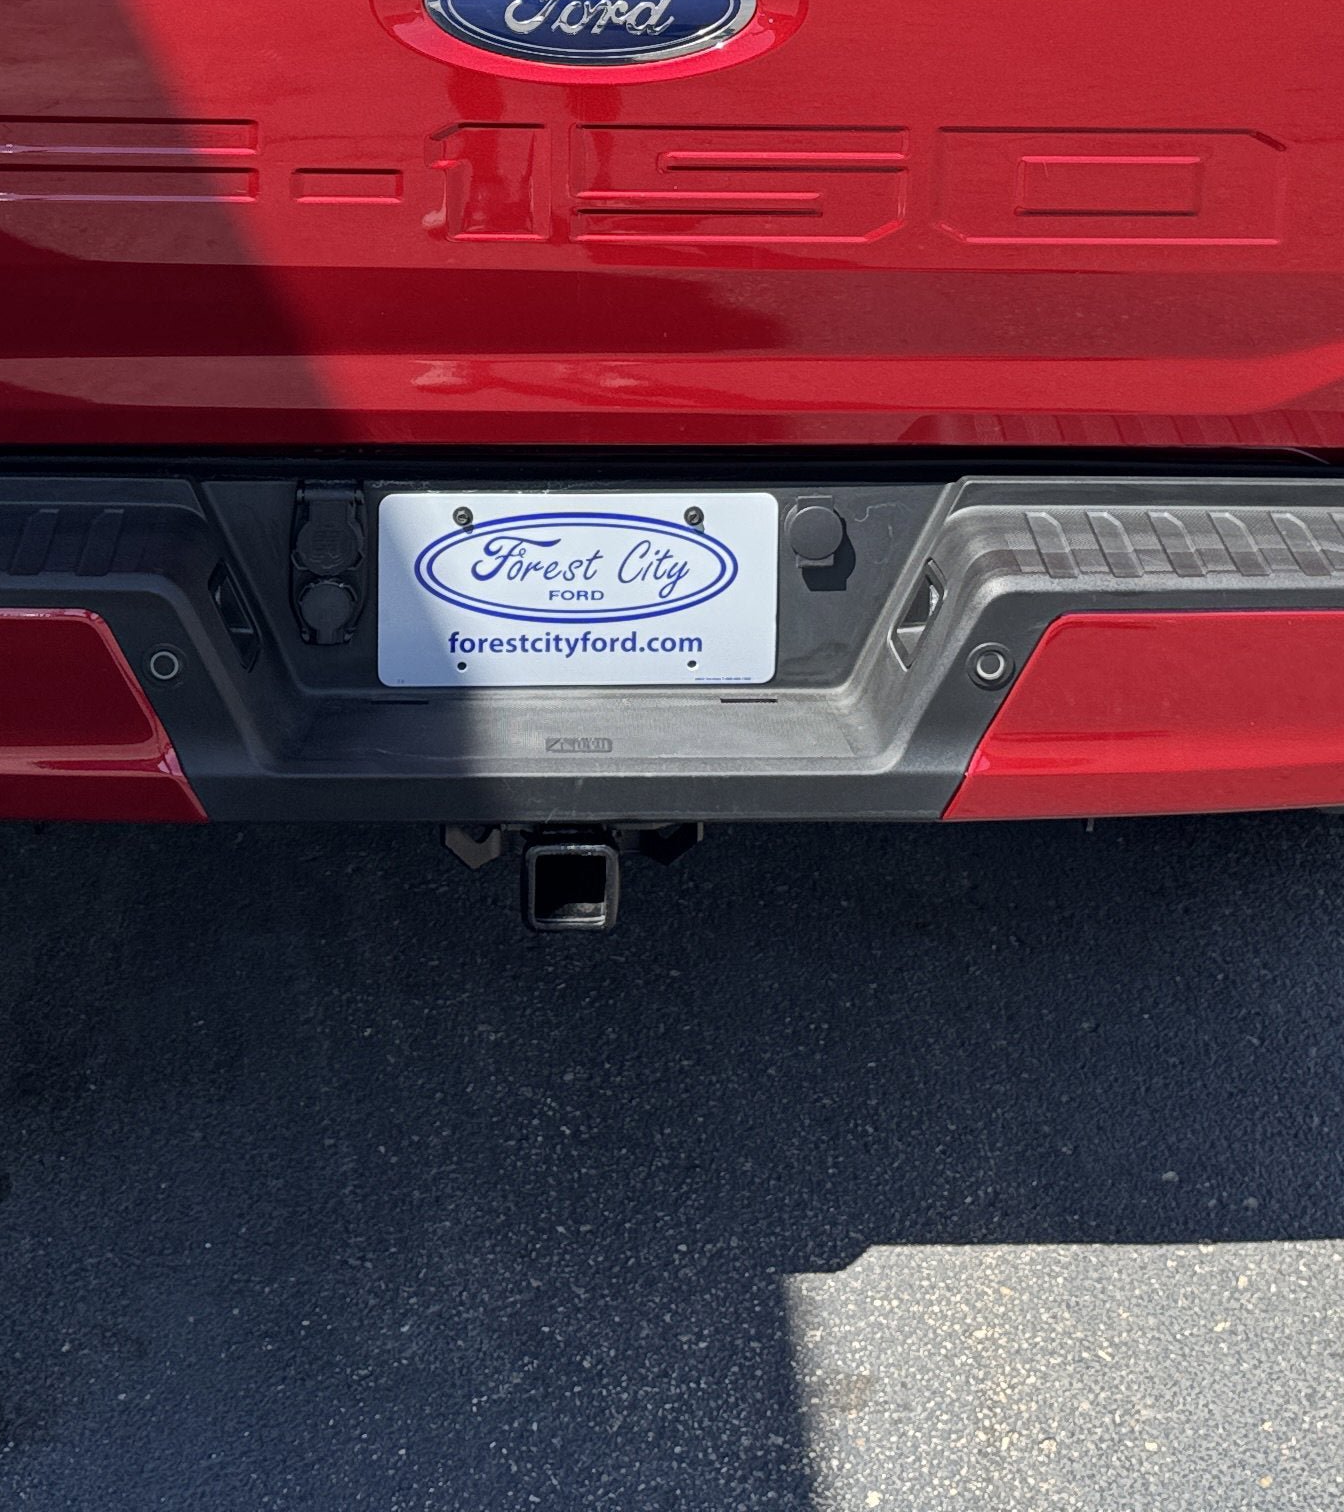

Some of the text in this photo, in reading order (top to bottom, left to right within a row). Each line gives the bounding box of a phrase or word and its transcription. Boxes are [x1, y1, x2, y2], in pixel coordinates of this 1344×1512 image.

[471, 536, 690, 599] Forest City
[548, 590, 605, 601] FORD
[448, 632, 703, 658] forestcityford.com
